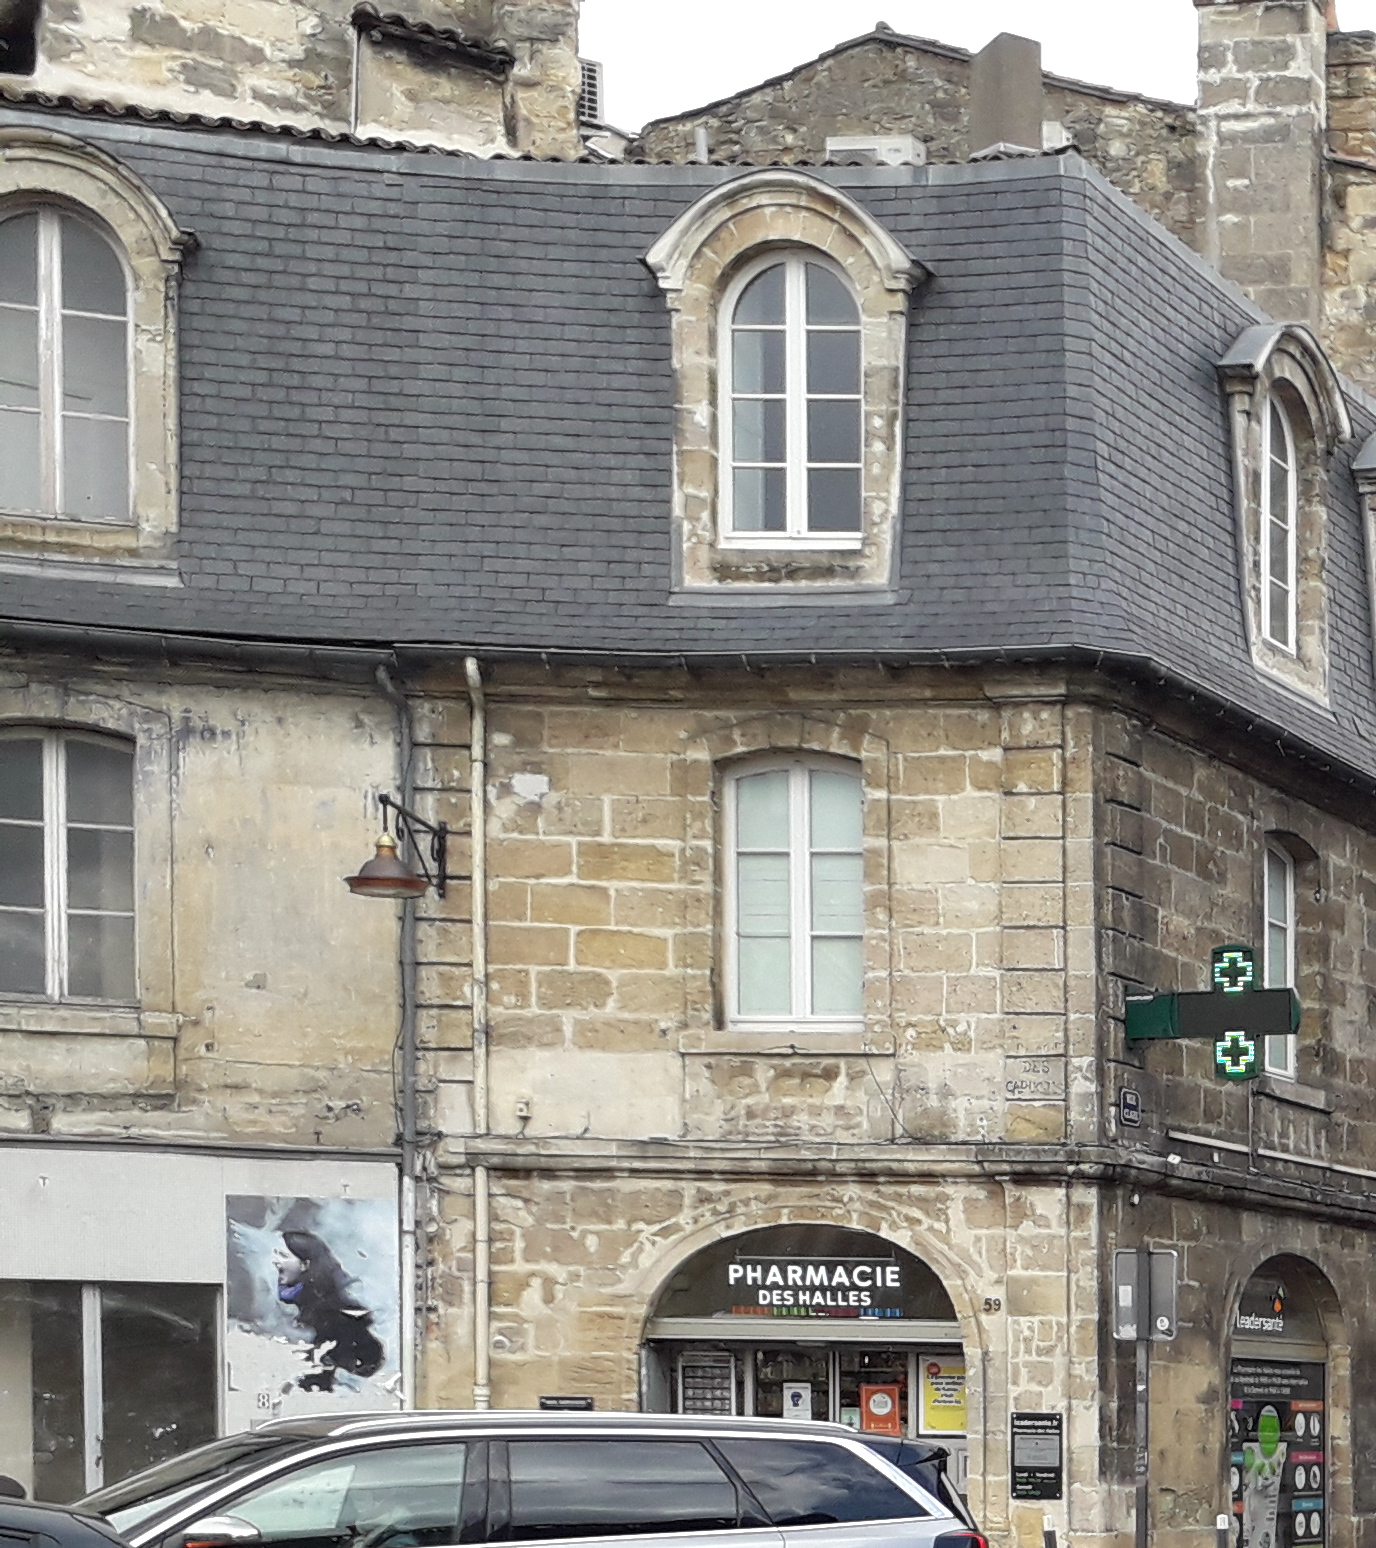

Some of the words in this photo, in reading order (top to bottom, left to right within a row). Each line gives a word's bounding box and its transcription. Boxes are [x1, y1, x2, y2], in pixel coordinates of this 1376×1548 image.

[728, 1264, 900, 1288] PHARMACIE
[758, 1289, 794, 1305] DES
[798, 1290, 871, 1306] HALLES
[983, 1297, 1001, 1312] 59
